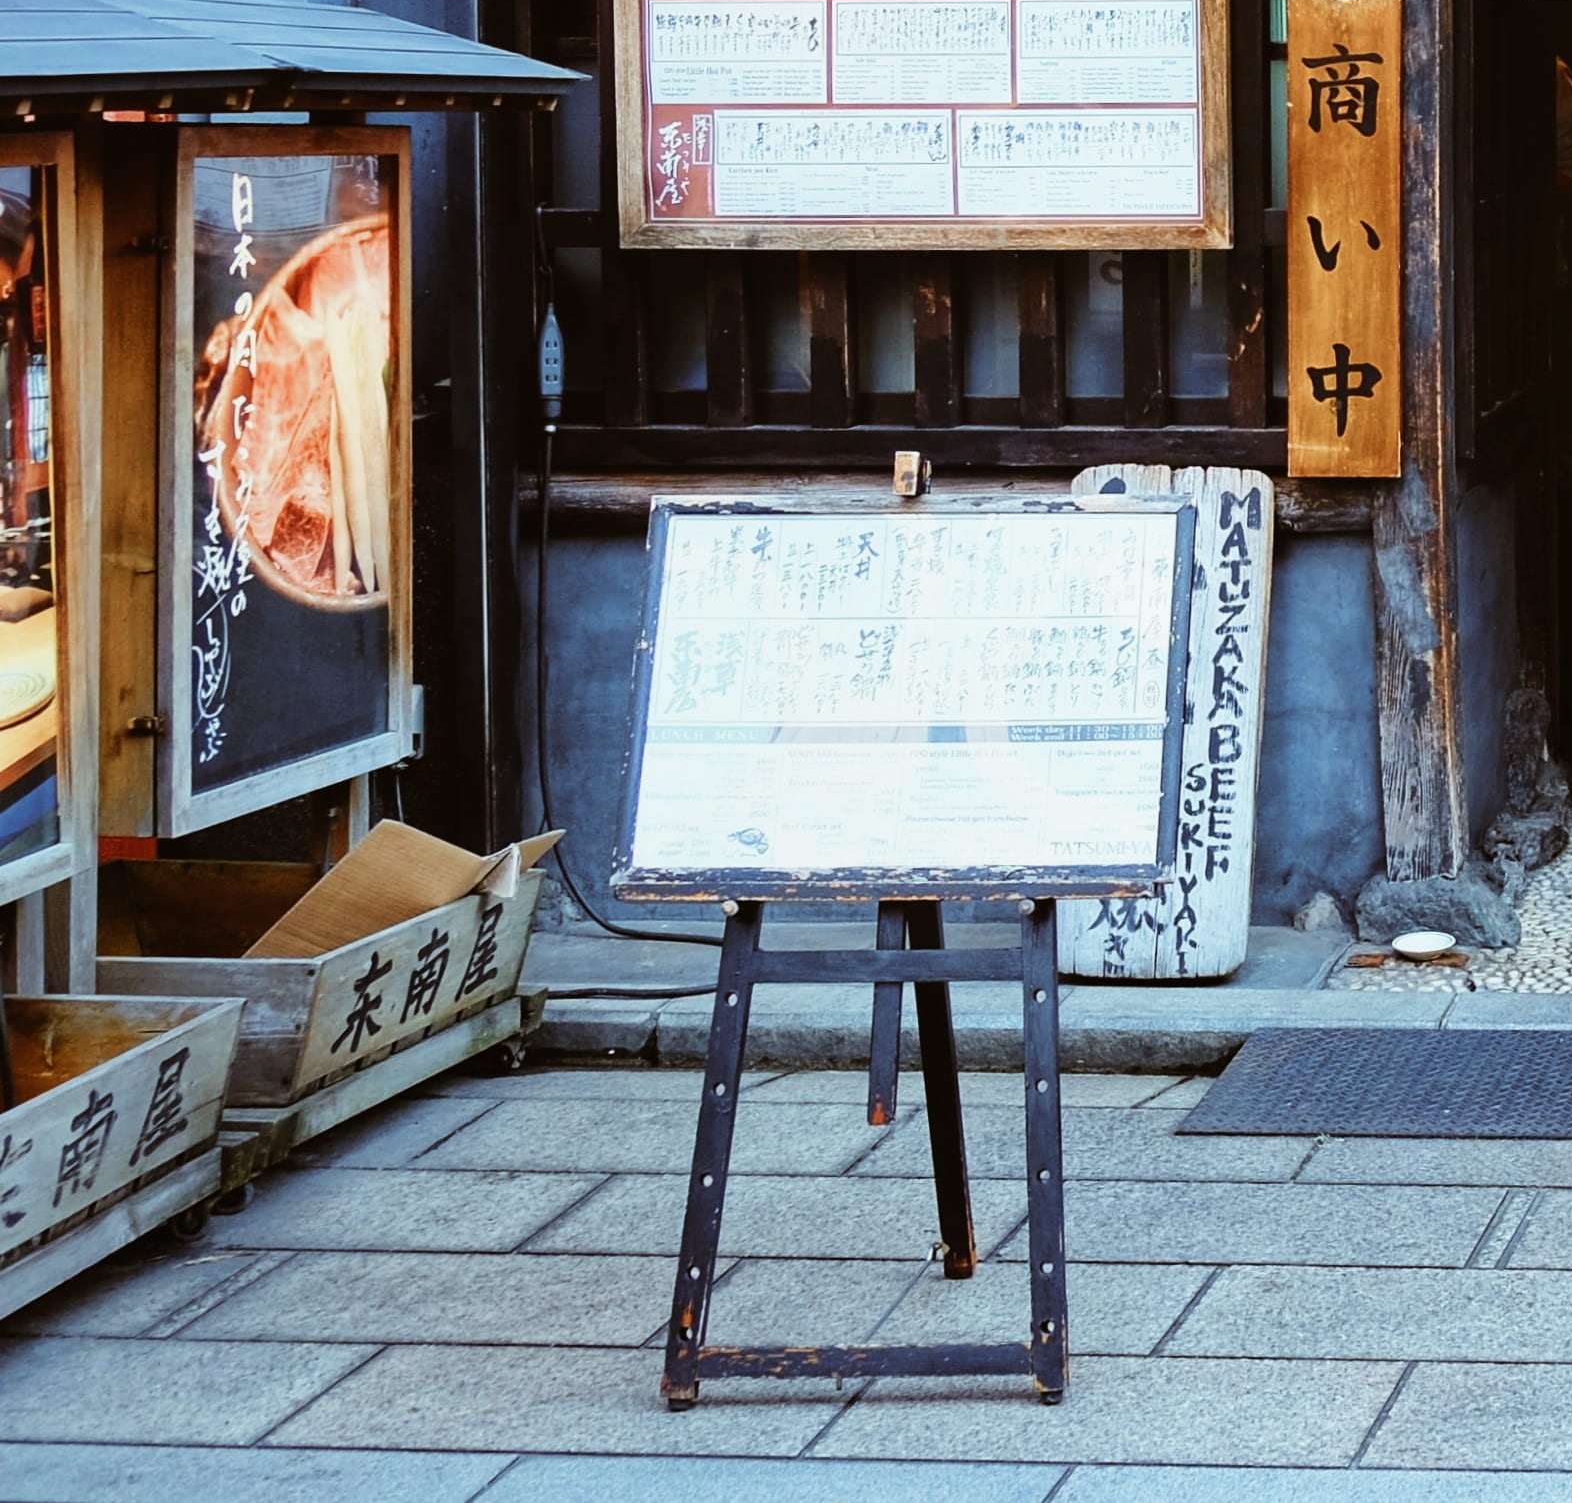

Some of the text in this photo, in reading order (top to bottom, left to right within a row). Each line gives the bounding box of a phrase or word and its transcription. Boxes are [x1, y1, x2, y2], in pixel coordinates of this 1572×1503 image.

[1301, 42, 1384, 438] 商い中
[228, 173, 258, 380] 日本の肉
[650, 729, 760, 741] LUNCH MENU
[1011, 733, 1043, 741] Week
[1012, 725, 1044, 733] Week
[1046, 726, 1065, 734] day
[1204, 725, 1242, 881] BEEF
[1050, 841, 1154, 857] TATSUMI-YA
